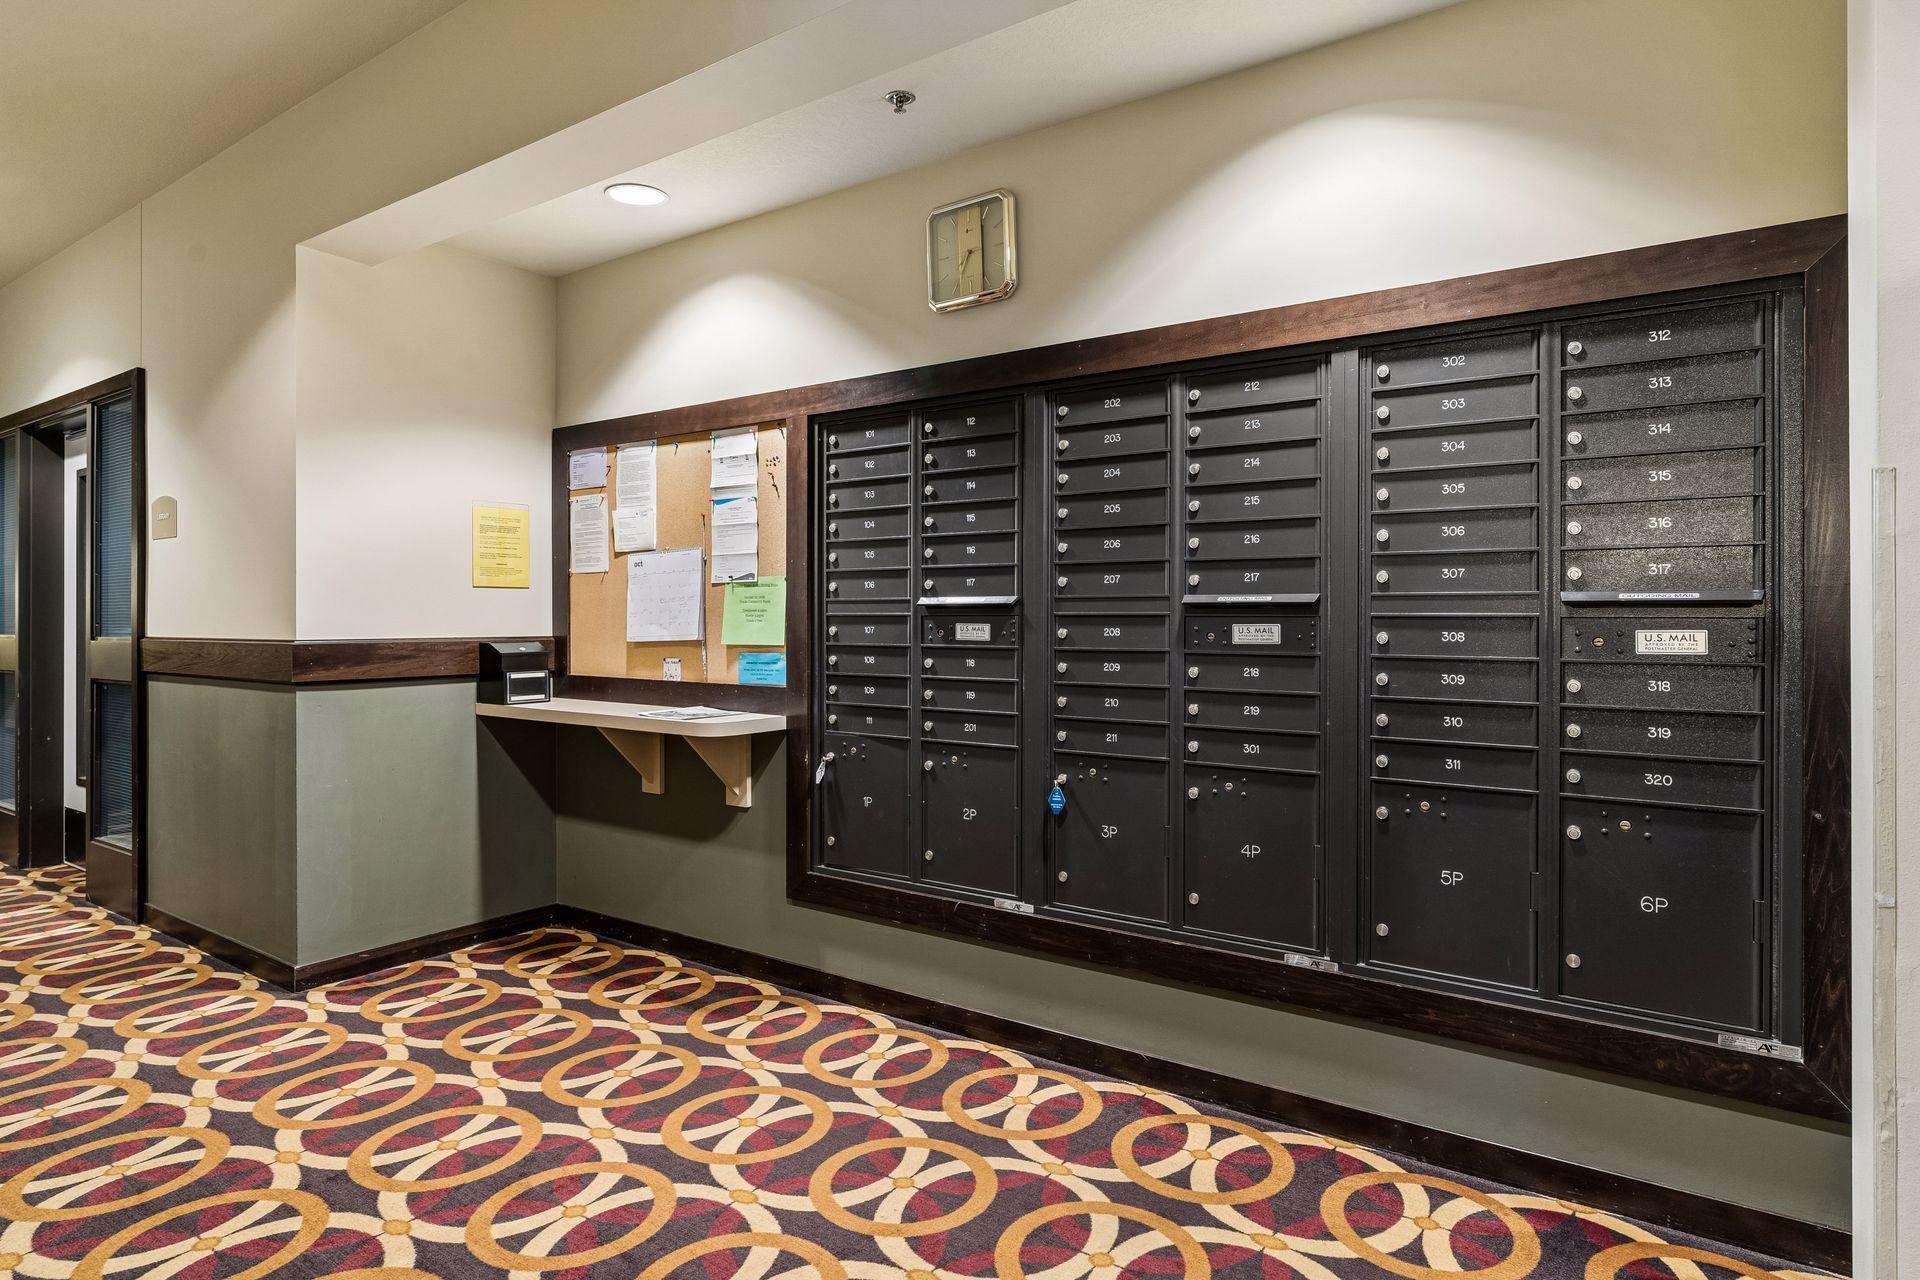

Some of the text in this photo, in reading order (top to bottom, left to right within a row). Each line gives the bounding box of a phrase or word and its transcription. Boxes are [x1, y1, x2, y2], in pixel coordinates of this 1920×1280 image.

[1648, 329, 1672, 343] 312
[1442, 355, 1466, 368] 302
[1244, 381, 1260, 392] 212
[1648, 376, 1672, 389] 313
[1104, 398, 1121, 409] 202
[1441, 397, 1466, 410] 303
[966, 416, 976, 426] 112
[1244, 419, 1261, 430] 213
[865, 430, 875, 439] 101
[1648, 422, 1672, 436] 314
[1104, 433, 1121, 444] 203
[1441, 440, 1466, 453] 304
[966, 448, 977, 458] 113
[864, 460, 875, 469] 102
[1244, 457, 1261, 468] 214
[1103, 467, 1121, 478] 204
[1648, 469, 1672, 482] 315
[1441, 482, 1466, 495] 305
[864, 490, 875, 499] 103
[1244, 495, 1261, 506] 215
[1103, 503, 1121, 514] 205
[864, 520, 875, 529] 104
[1648, 516, 1672, 530] 316
[1441, 525, 1466, 537] 306
[1103, 539, 1121, 549] 206
[1243, 534, 1261, 544] 216
[864, 550, 875, 559] 105
[1441, 568, 1466, 579] 307
[1648, 562, 1672, 575] 317
[966, 578, 976, 587] 117
[1103, 574, 1121, 584] 207
[1244, 572, 1260, 582] 217
[864, 580, 875, 589] 106
[864, 625, 875, 634] 107
[1441, 631, 1466, 643] 308
[1644, 633, 1698, 642] U.S. MAIL
[864, 656, 875, 664] 108
[1103, 662, 1121, 672] 209
[1243, 667, 1260, 678] 218
[1440, 674, 1466, 685] 309
[863, 686, 875, 695] 109
[1647, 680, 1671, 692] 318
[965, 691, 976, 700] 119
[1104, 697, 1119, 707] 210
[1243, 705, 1260, 716] 219
[865, 716, 873, 725] 111
[1443, 716, 1464, 728] 310
[964, 722, 977, 732] 201
[1647, 726, 1672, 739] 319
[1106, 733, 1118, 743] 211
[1243, 743, 1260, 754] 301
[1445, 758, 1461, 770] 311
[1644, 773, 1673, 787] 320
[863, 796, 873, 807] 1P
[962, 807, 977, 821] 2P
[1101, 824, 1118, 839] 3P
[1240, 844, 1261, 859] 4P
[1440, 870, 1464, 886] 5P
[1640, 895, 1669, 914] 6P
